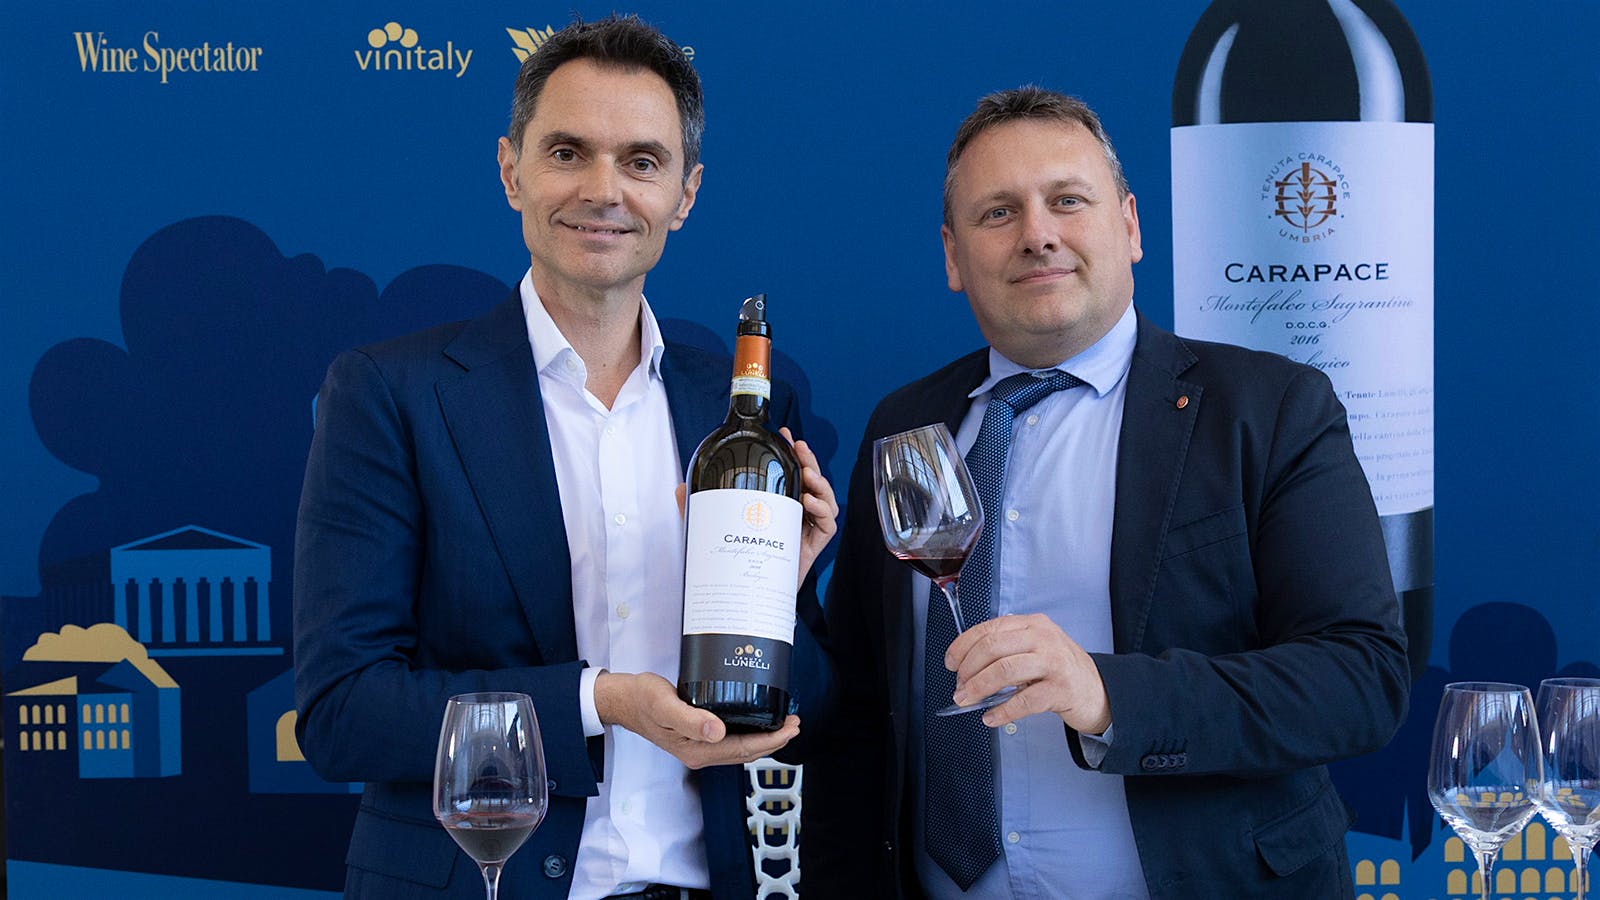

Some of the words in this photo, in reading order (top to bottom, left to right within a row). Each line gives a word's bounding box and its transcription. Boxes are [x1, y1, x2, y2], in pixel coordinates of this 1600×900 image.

[73, 31, 138, 72] Wine
[143, 30, 263, 84] Spectator
[354, 41, 473, 78] vinitaly
[1261, 156, 1293, 200] TENUTA
[1298, 152, 1350, 200] CARAPACE
[1279, 227, 1335, 243] UMBRIA
[1224, 263, 1389, 283] CARAPACE
[1199, 289, 1305, 325] Montefalco
[1312, 293, 1414, 325] Sagrantino
[1285, 321, 1331, 329] D.O.C.G.
[1290, 333, 1321, 345] 2016
[724, 534, 784, 550] CARAPACE
[724, 657, 770, 670] LUNELLI
